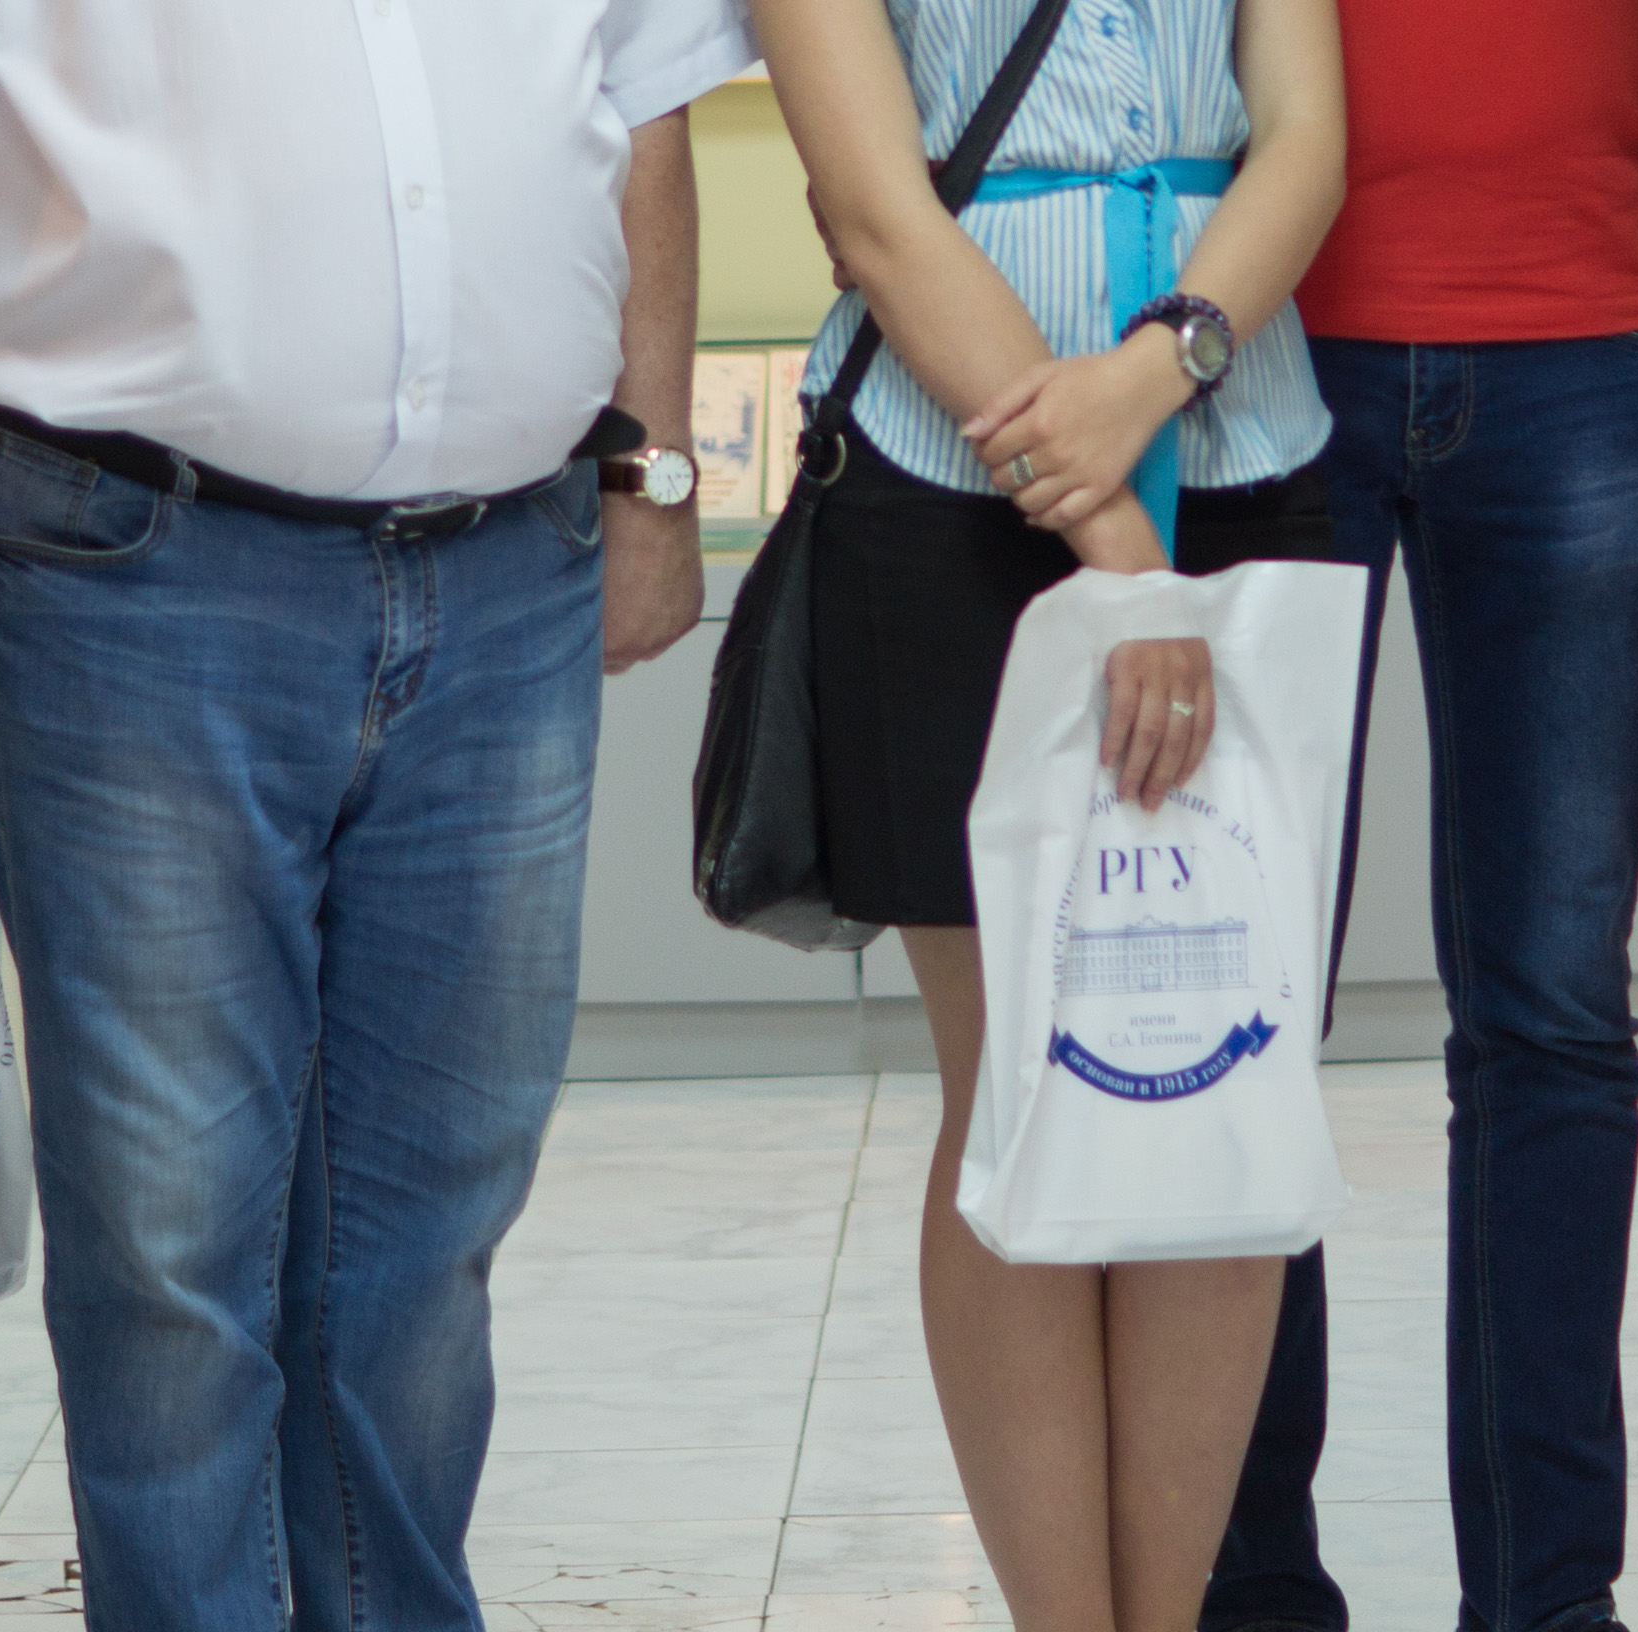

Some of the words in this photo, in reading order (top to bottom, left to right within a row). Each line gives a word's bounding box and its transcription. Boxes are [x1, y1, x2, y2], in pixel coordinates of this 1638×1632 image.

[1097, 844, 1198, 896] РГУ
[1129, 1013, 1177, 1028] имени
[1140, 1030, 1203, 1047] Есенина
[1067, 1049, 1135, 1096] основан
[1154, 1070, 1200, 1096] 1915
[1200, 1051, 1234, 1081] году
